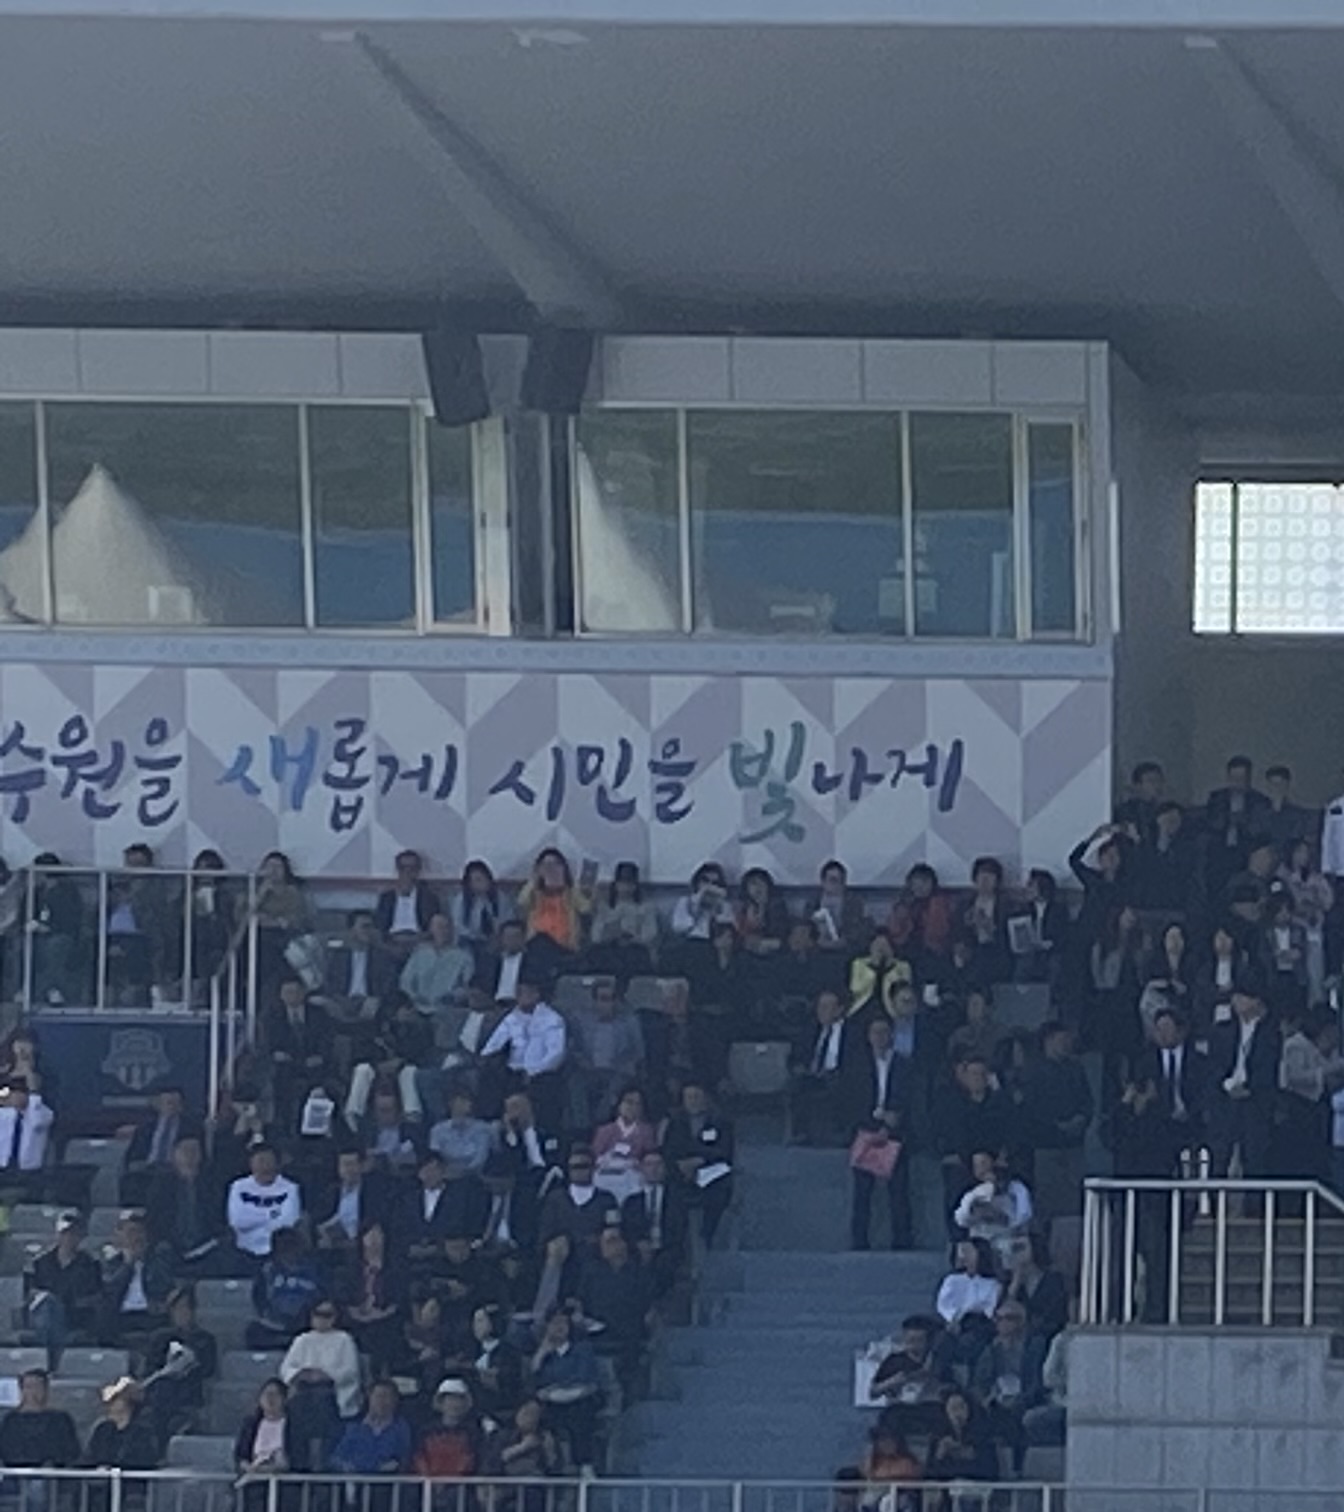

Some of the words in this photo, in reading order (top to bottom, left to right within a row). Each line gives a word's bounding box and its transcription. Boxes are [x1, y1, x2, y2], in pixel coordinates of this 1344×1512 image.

[0, 714, 183, 828] 수원을
[215, 717, 459, 833] 새롭게
[488, 736, 697, 824] 시민을
[729, 720, 965, 844] 빛나게
